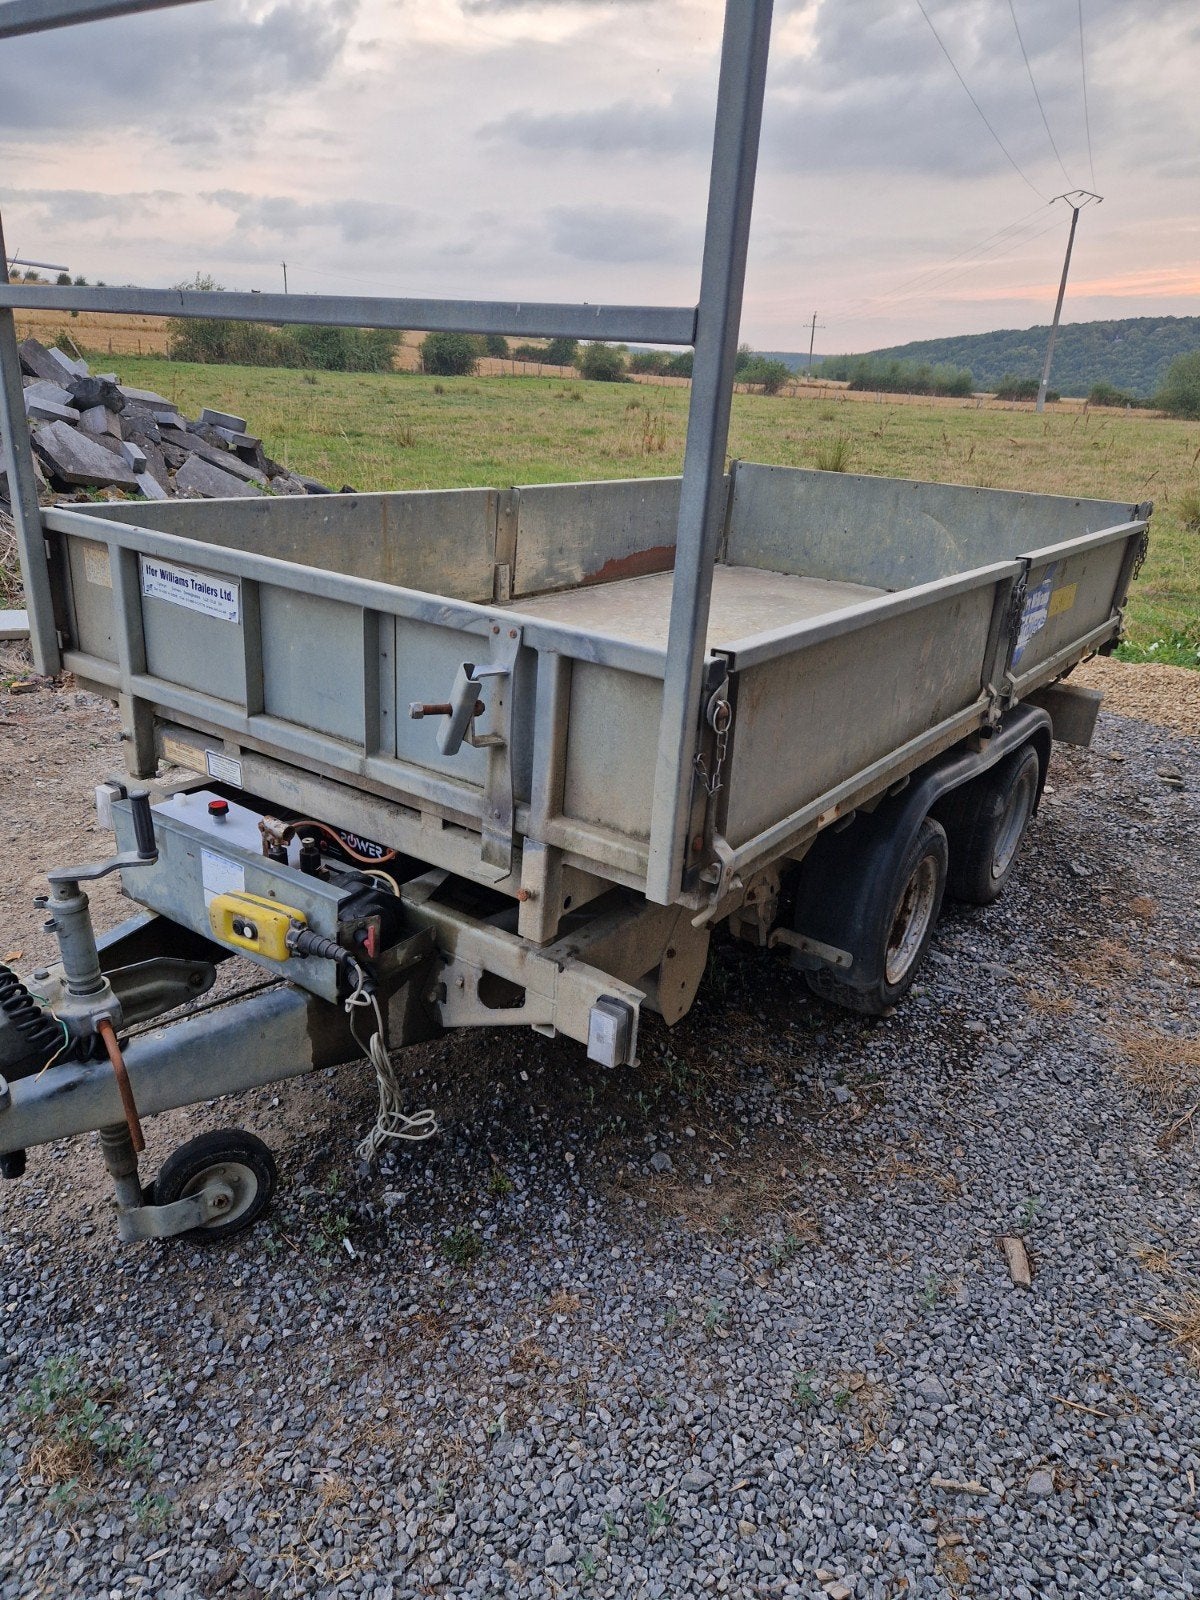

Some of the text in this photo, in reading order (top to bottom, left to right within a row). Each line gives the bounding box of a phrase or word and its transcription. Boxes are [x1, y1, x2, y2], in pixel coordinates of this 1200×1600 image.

[145, 564, 158, 577] Ifor
[159, 568, 189, 588] Williams
[190, 578, 218, 598] Trailers
[219, 588, 234, 603] Ltd.
